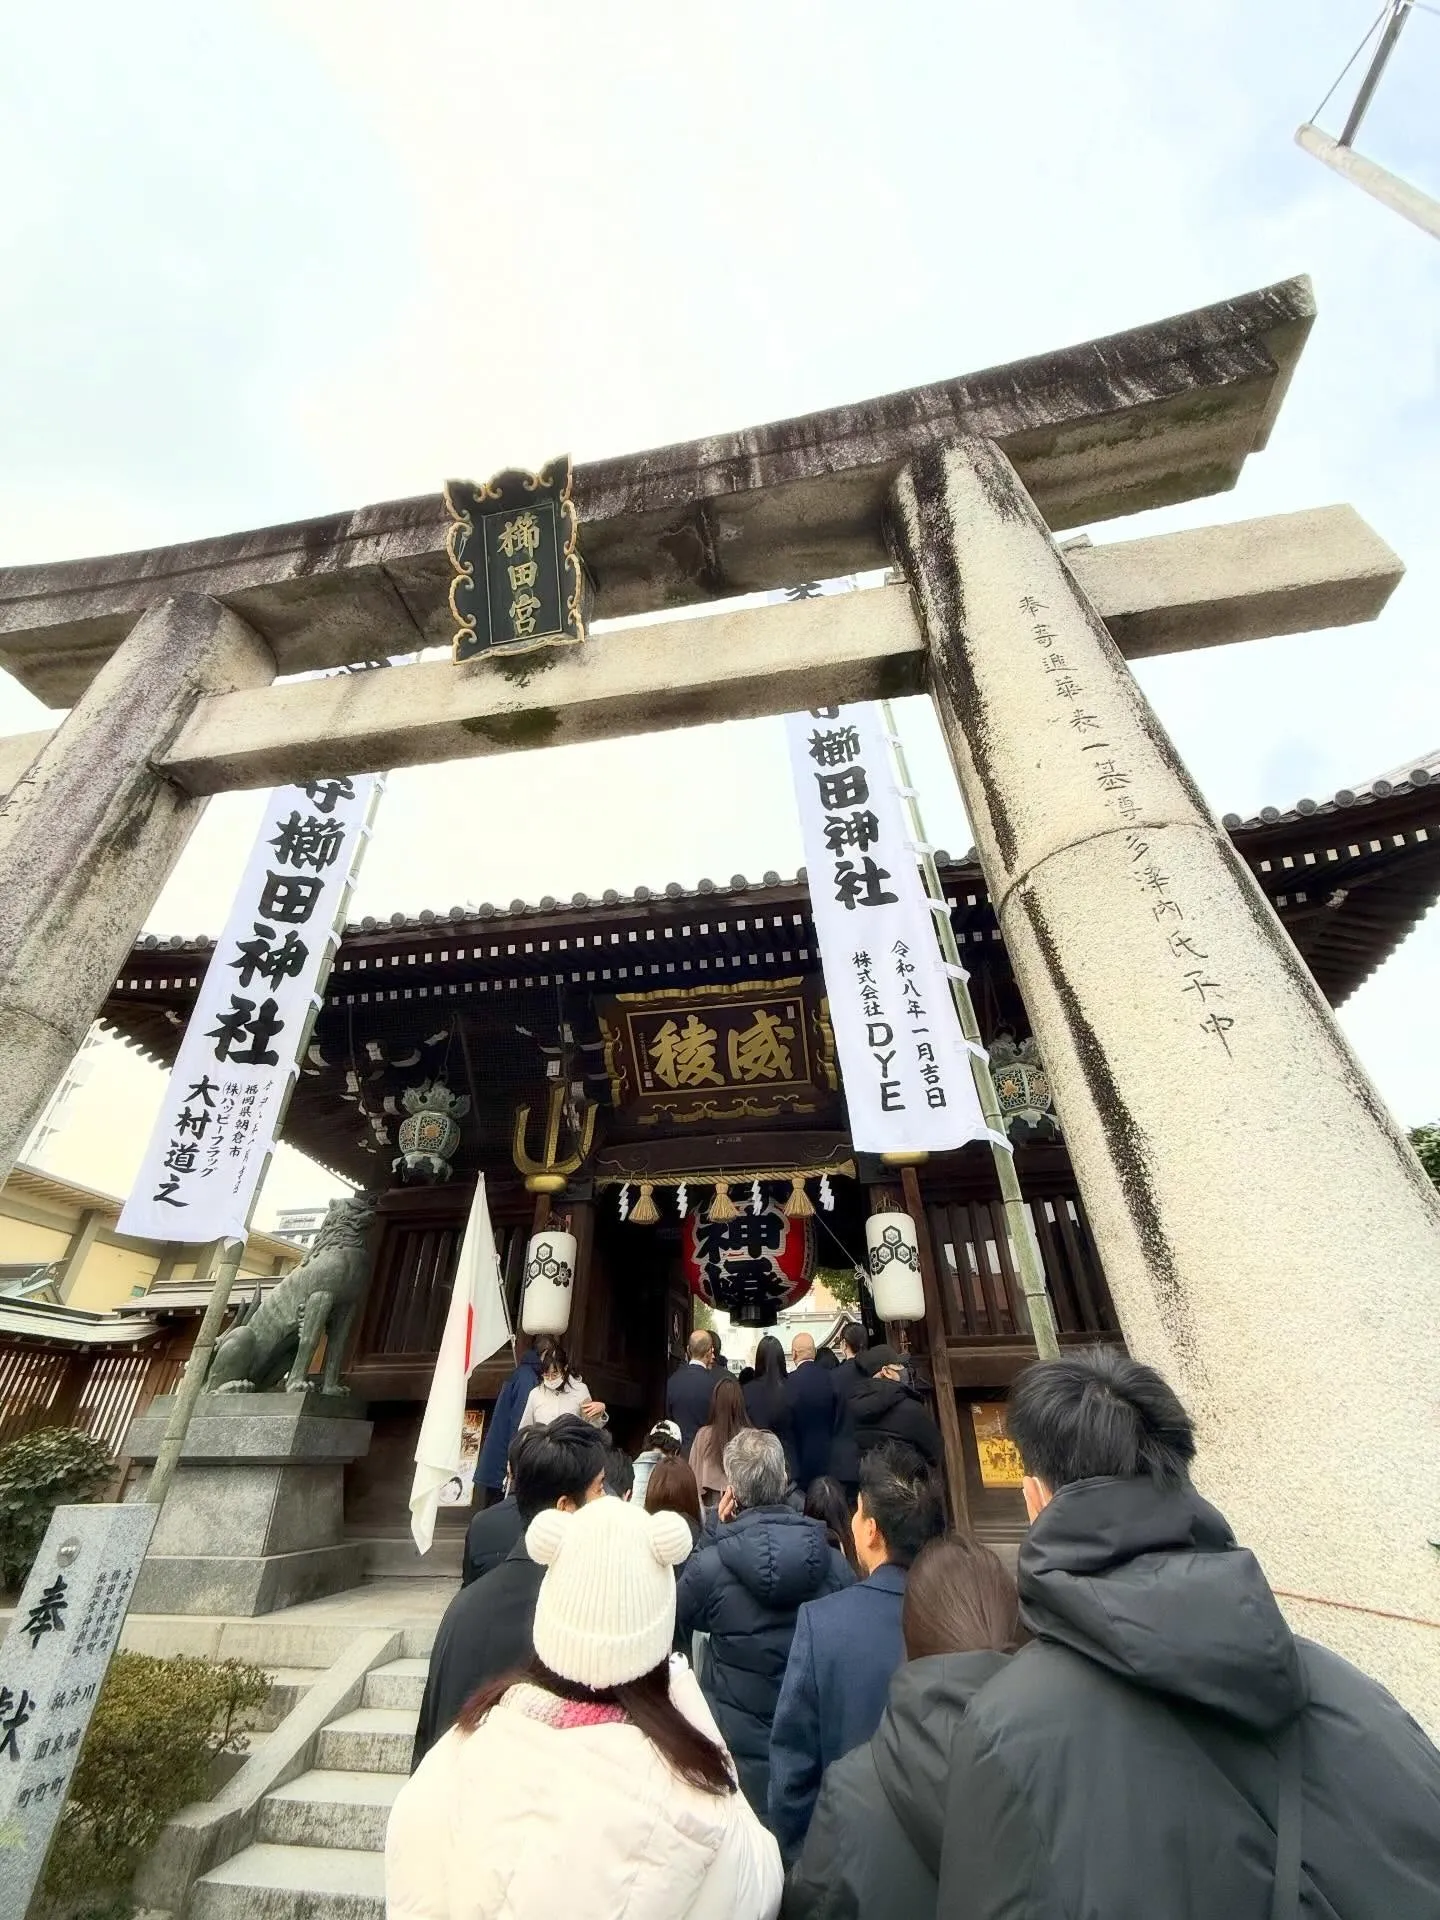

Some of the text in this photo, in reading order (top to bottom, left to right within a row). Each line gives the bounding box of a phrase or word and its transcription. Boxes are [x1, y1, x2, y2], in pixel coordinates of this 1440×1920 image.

[496, 512, 542, 634] 櫛田宮
[807, 705, 900, 911] 櫛田神社
[892, 939, 947, 1110] 令和八年一月吉日
[152, 1074, 220, 1207] 大村道之
[230, 1084, 259, 1158] 福岡県朝倉市
